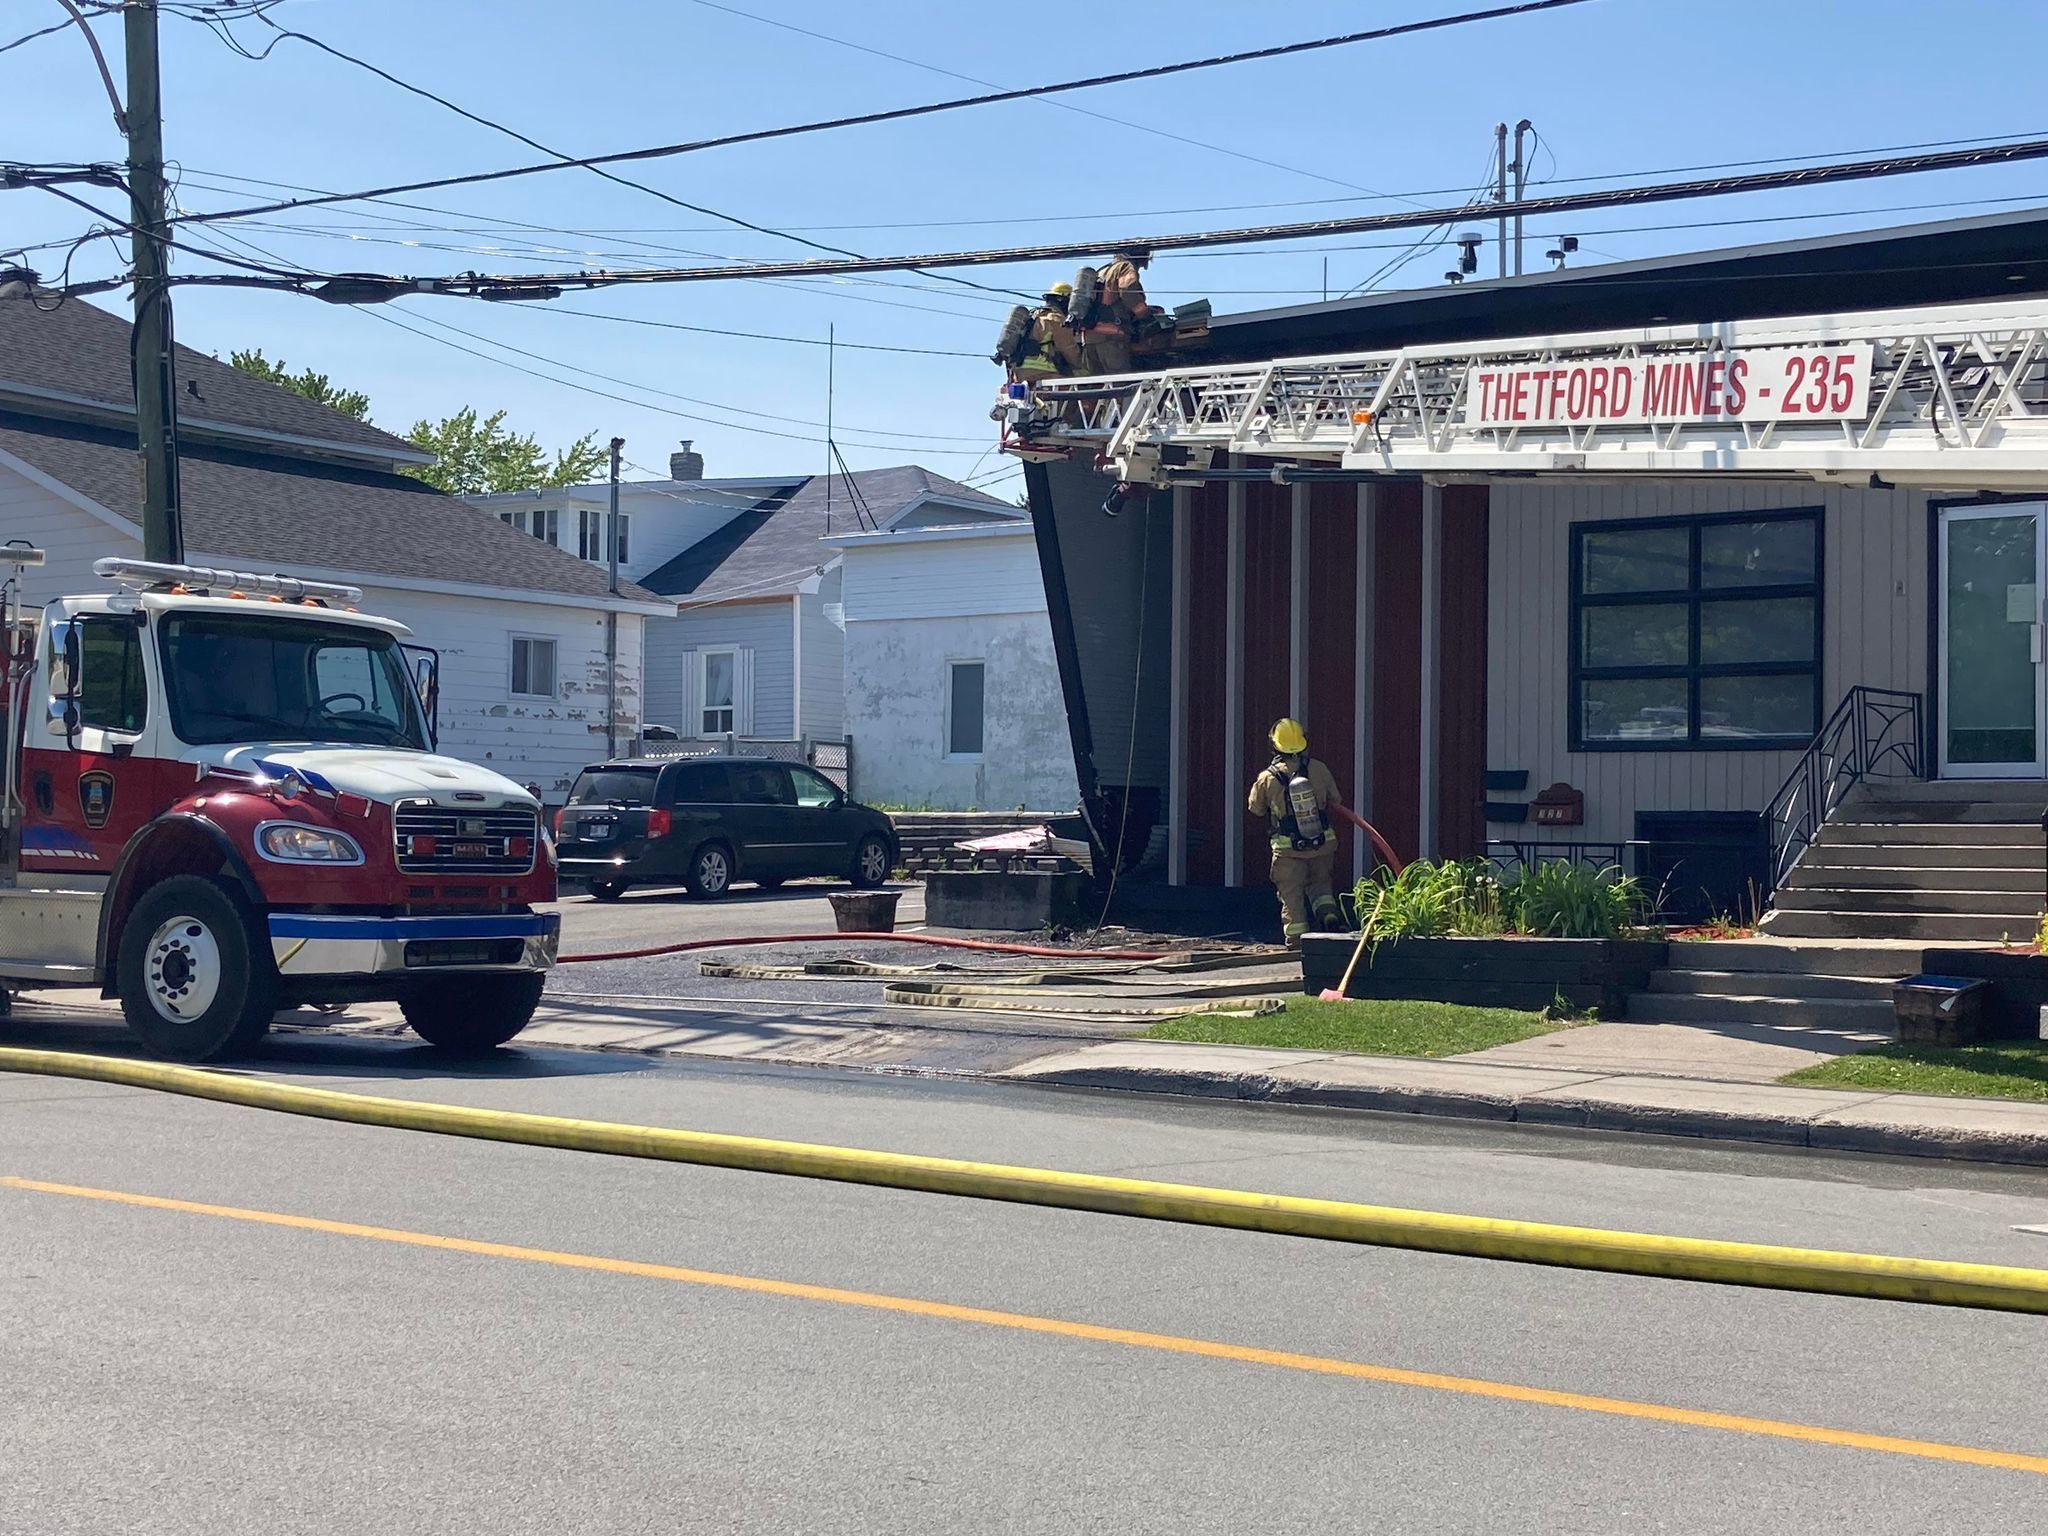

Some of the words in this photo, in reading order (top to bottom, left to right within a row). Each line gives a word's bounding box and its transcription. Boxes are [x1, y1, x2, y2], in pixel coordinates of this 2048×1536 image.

[1478, 366, 1633, 423] THETFORD
[1640, 358, 1749, 417] MINES
[1758, 387, 1771, 398] -
[1780, 353, 1856, 414] 235
